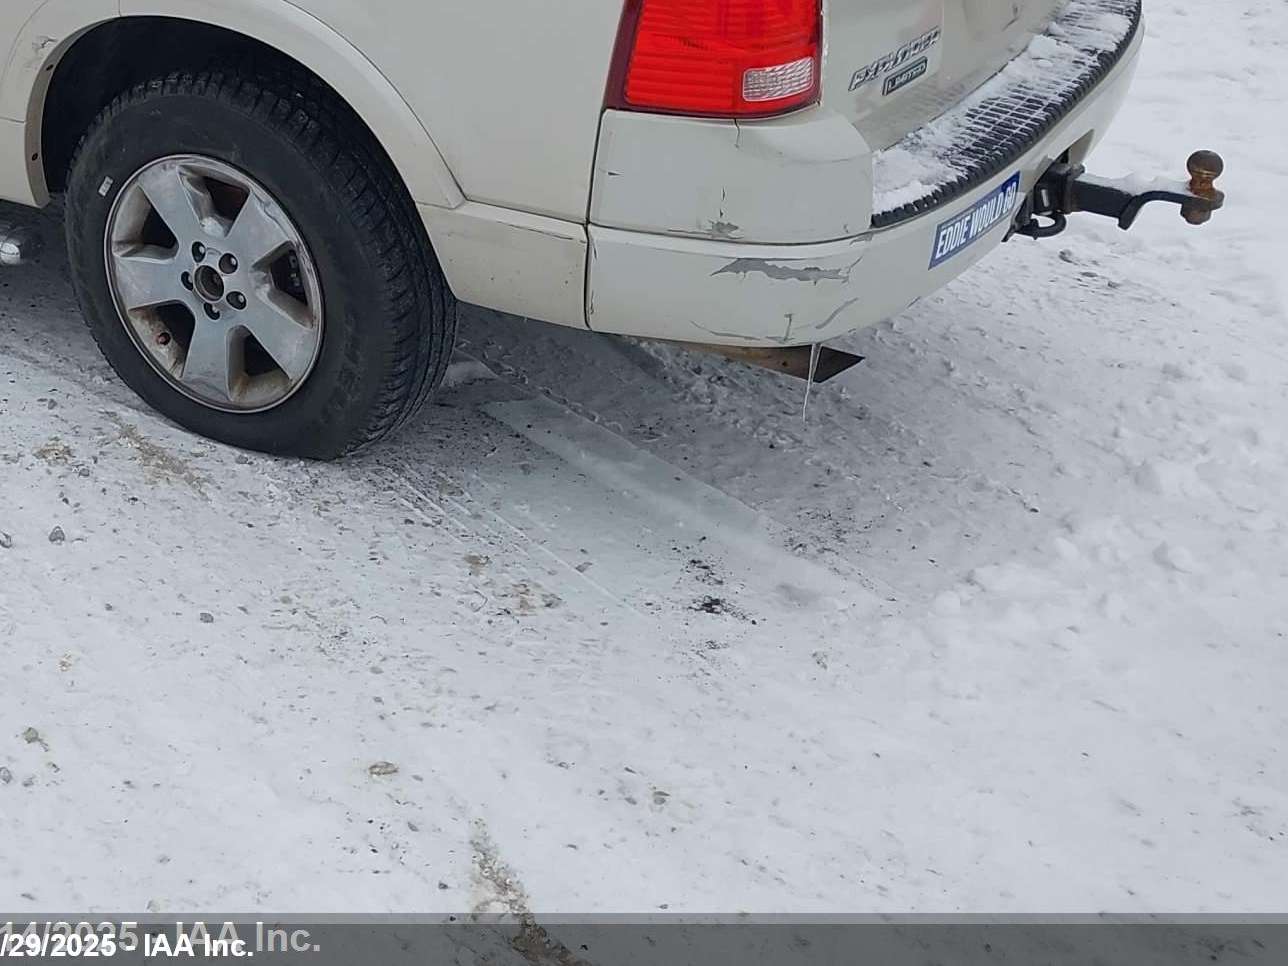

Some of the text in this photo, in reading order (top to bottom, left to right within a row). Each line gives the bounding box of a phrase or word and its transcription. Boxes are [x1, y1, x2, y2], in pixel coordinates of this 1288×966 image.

[935, 181, 1017, 260] EDDIE WOULD GO
